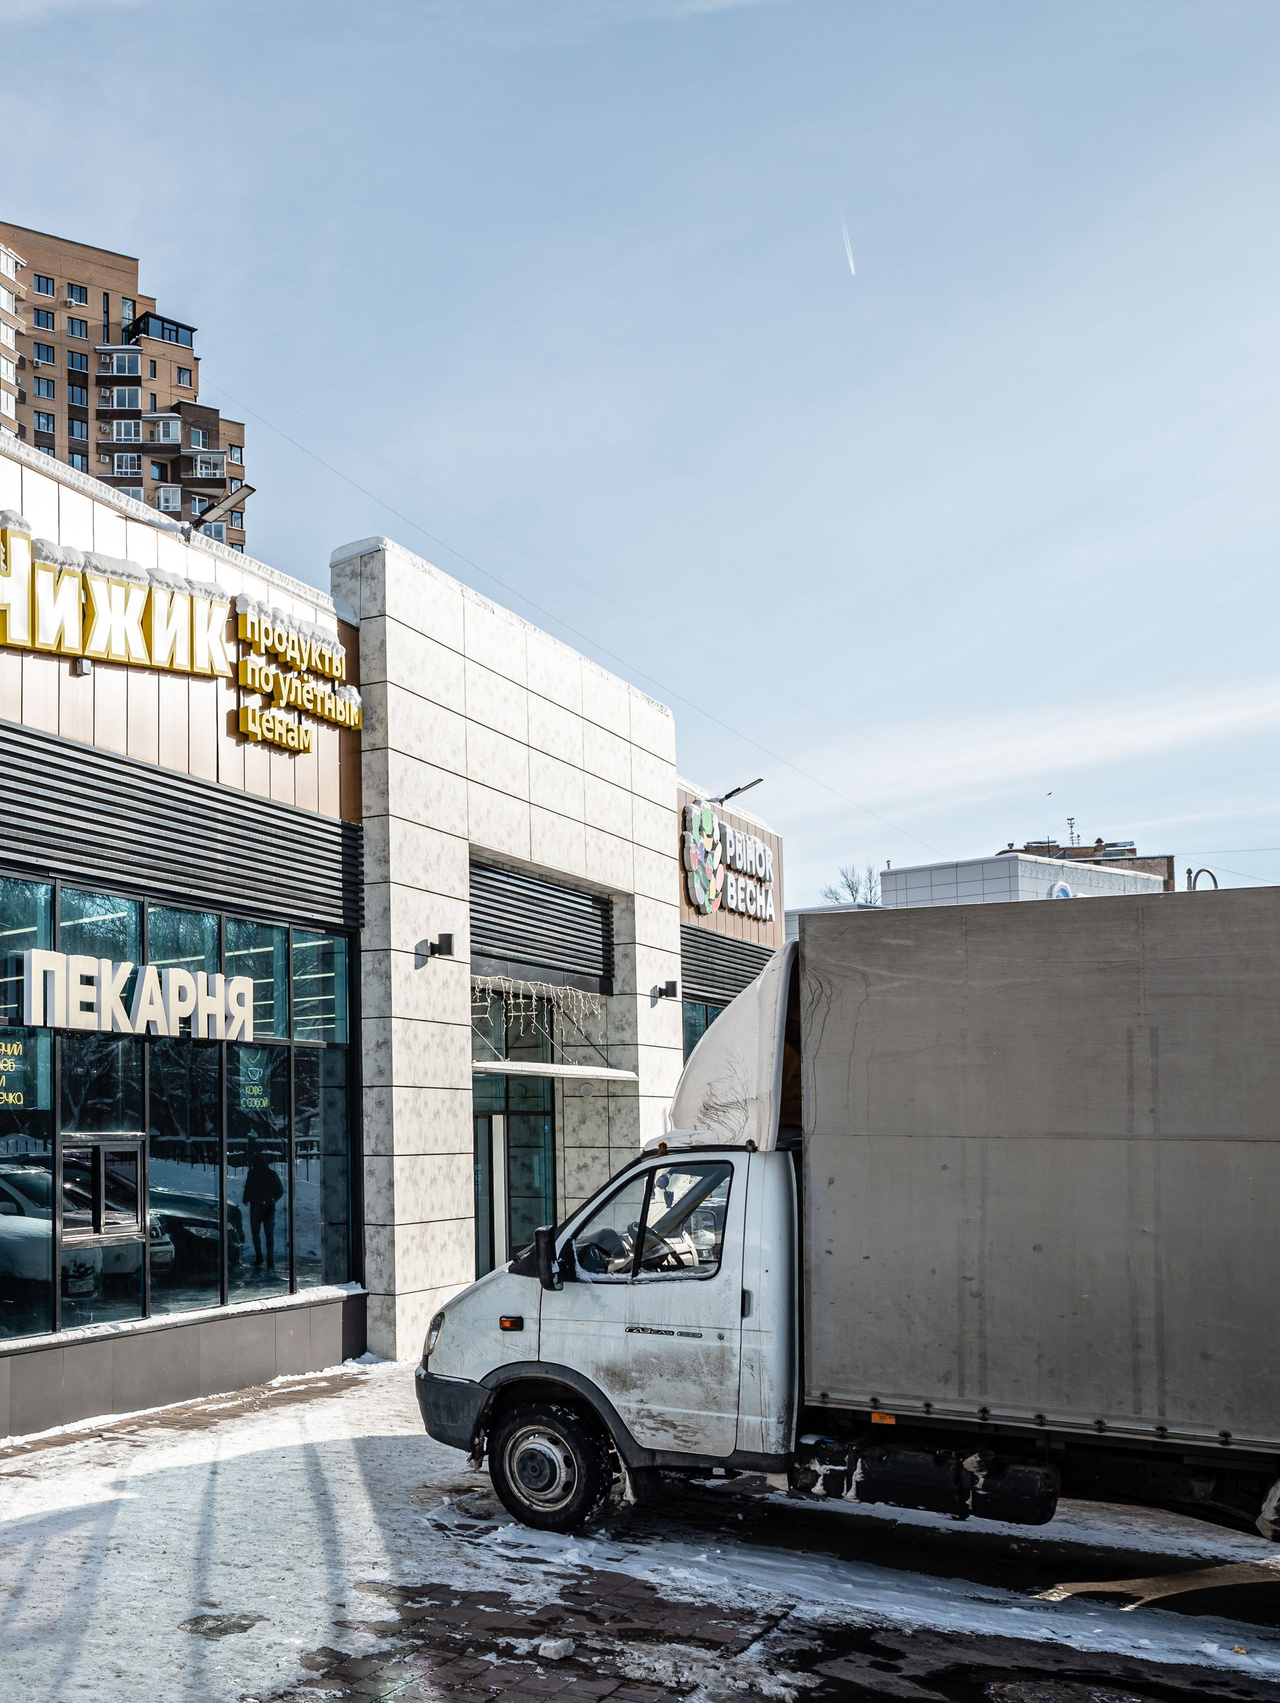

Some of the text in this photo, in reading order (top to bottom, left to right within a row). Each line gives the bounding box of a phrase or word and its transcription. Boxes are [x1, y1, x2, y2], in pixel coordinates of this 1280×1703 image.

[239, 613, 347, 681] продукты
[239, 659, 273, 693] по
[240, 706, 313, 753] ценам
[723, 872, 776, 923] ВЕСНА
[24, 948, 254, 1042] ПЕКАРНЯ
